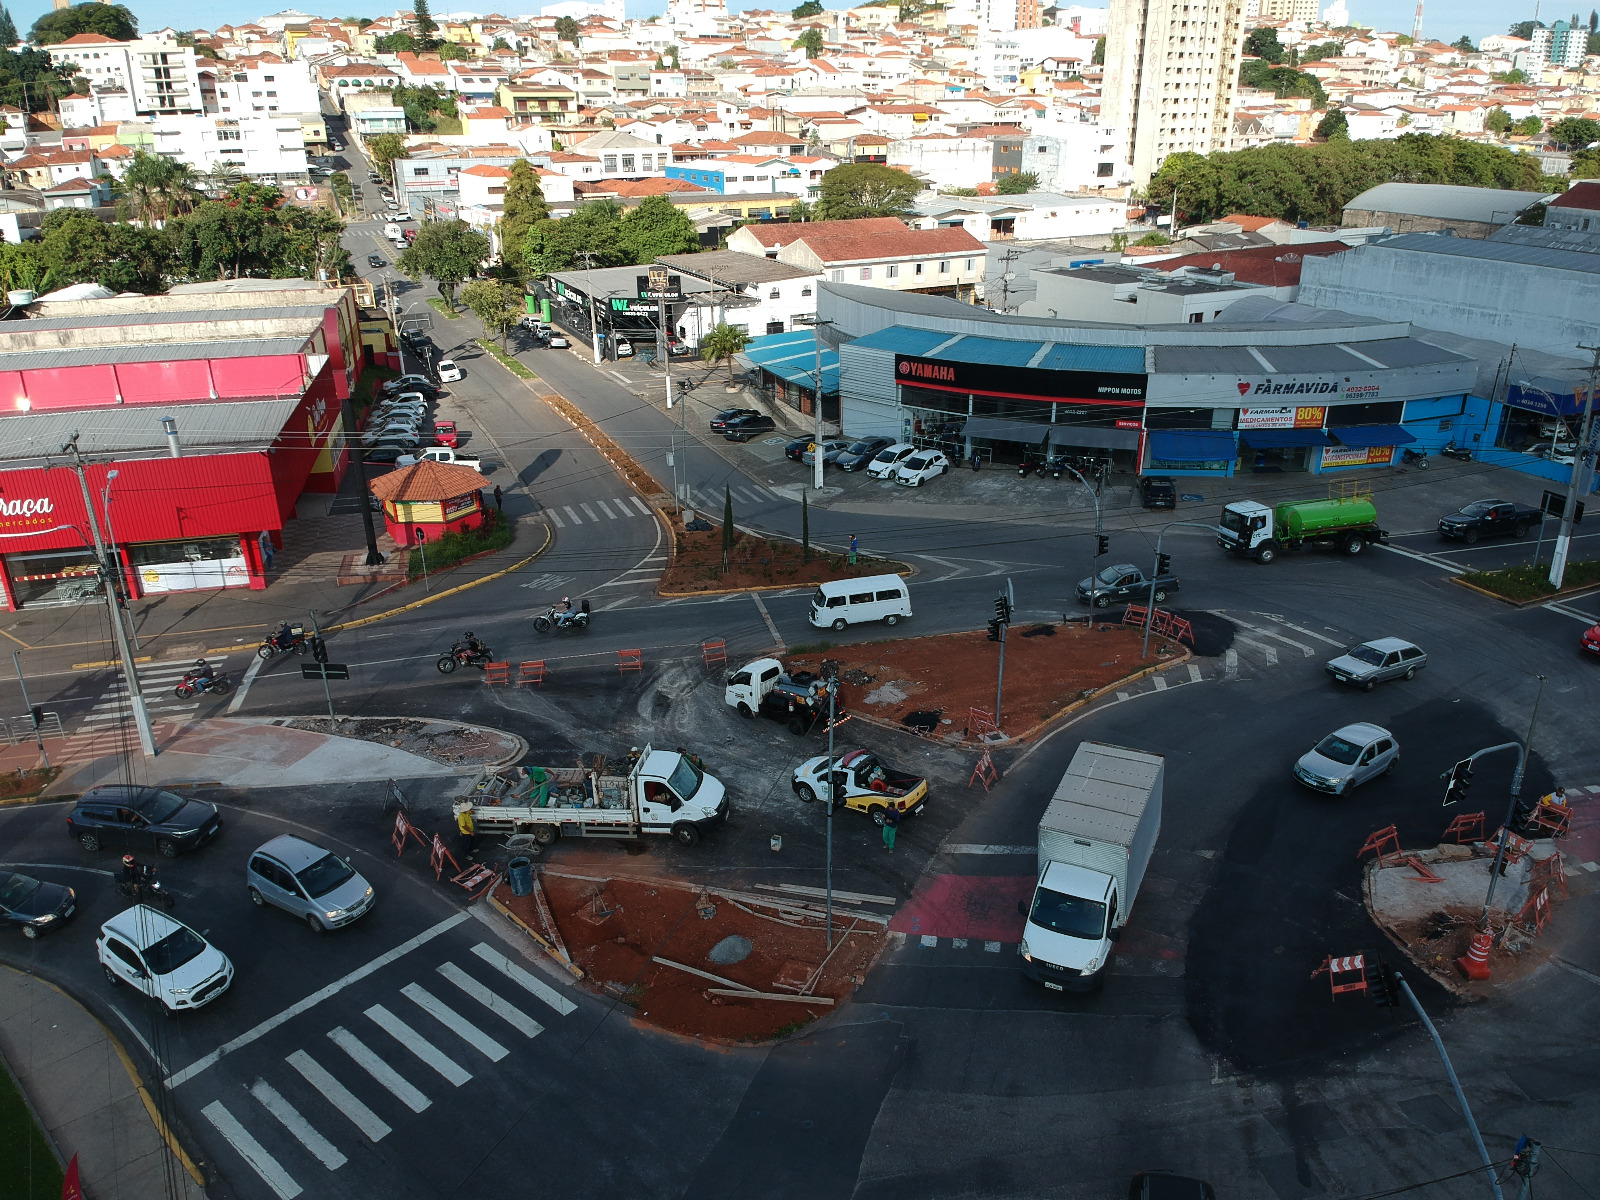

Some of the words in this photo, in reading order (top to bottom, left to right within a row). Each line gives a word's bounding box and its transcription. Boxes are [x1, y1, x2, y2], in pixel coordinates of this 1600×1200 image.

[910, 361, 955, 381] YAMAHA
[1097, 386, 1120, 394] NIPPON
[1254, 382, 1339, 395] FARMAVIDA
[1297, 407, 1322, 420] 80%
[1046, 963, 1064, 971] IVECO
